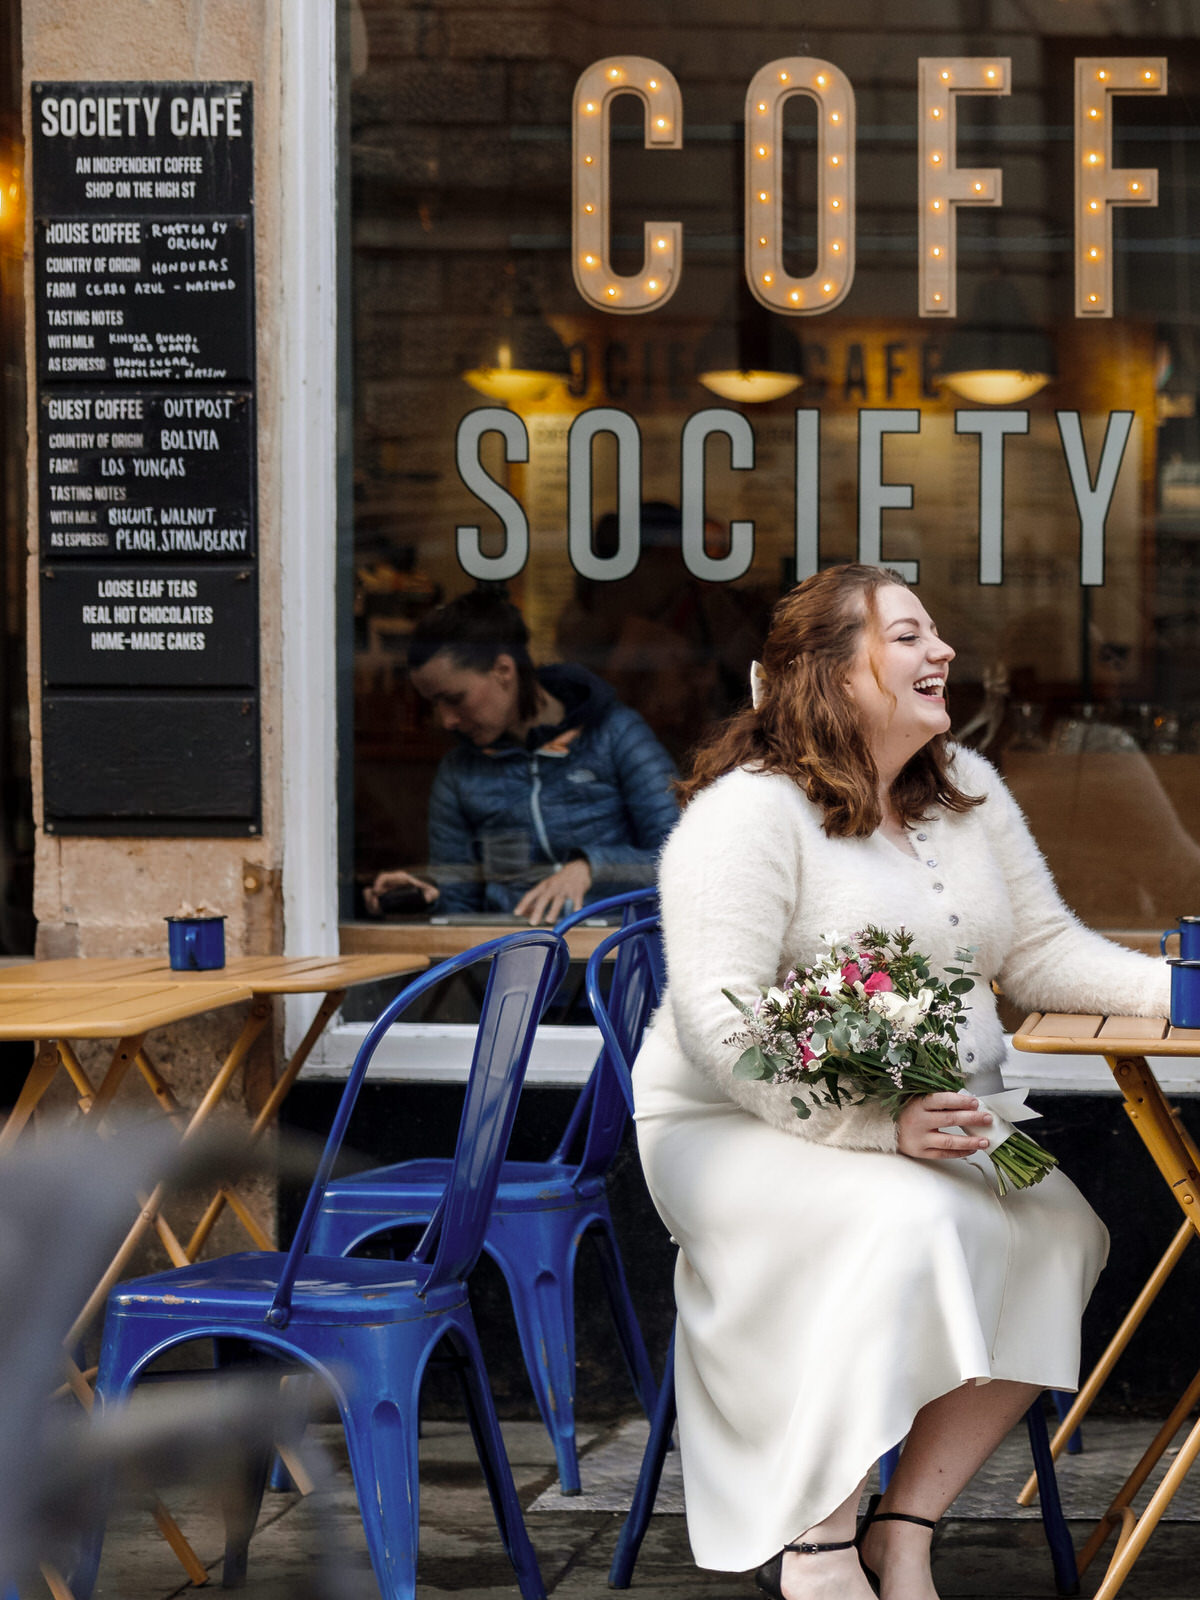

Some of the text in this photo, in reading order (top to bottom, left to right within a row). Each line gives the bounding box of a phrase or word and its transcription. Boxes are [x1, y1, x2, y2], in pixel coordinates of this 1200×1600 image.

[41, 92, 242, 137] SOCIETY CAFÉ
[75, 157, 203, 174] AN INDEPENDENT COFFEE
[85, 181, 196, 198] SHOP ON THE HIGH ST
[46, 223, 141, 244] HOUSE COFFEE
[167, 236, 218, 250] ORIGIN
[46, 257, 141, 273] COUNTRY OF ORIGIN
[151, 257, 229, 275] HONDURAS
[46, 282, 77, 298] FARM
[47, 310, 124, 326] TASTING NOTES
[48, 335, 95, 349] WITH MILK
[48, 357, 106, 371] AS ESPRESSO
[48, 399, 144, 420] GUEST COFFEE
[163, 398, 233, 419] OUTPOST
[49, 433, 144, 449] COUNTRY OF ORIGIN
[160, 429, 220, 451] BOLIVIA
[49, 458, 79, 474] FARM
[101, 457, 186, 479] LOS YUNGAS
[49, 486, 126, 501] TASTING NOTES
[455, 407, 1136, 586] SOCIETY
[50, 510, 97, 524] WITH MILK
[160, 507, 216, 525] WALNUT
[51, 532, 109, 547] AS ESPRESSO
[98, 580, 197, 597] LOOSE LEAF TEAS
[82, 606, 213, 624] REAL HOT CHOCOLATES
[91, 632, 205, 650] HOME-MADE CAKES
